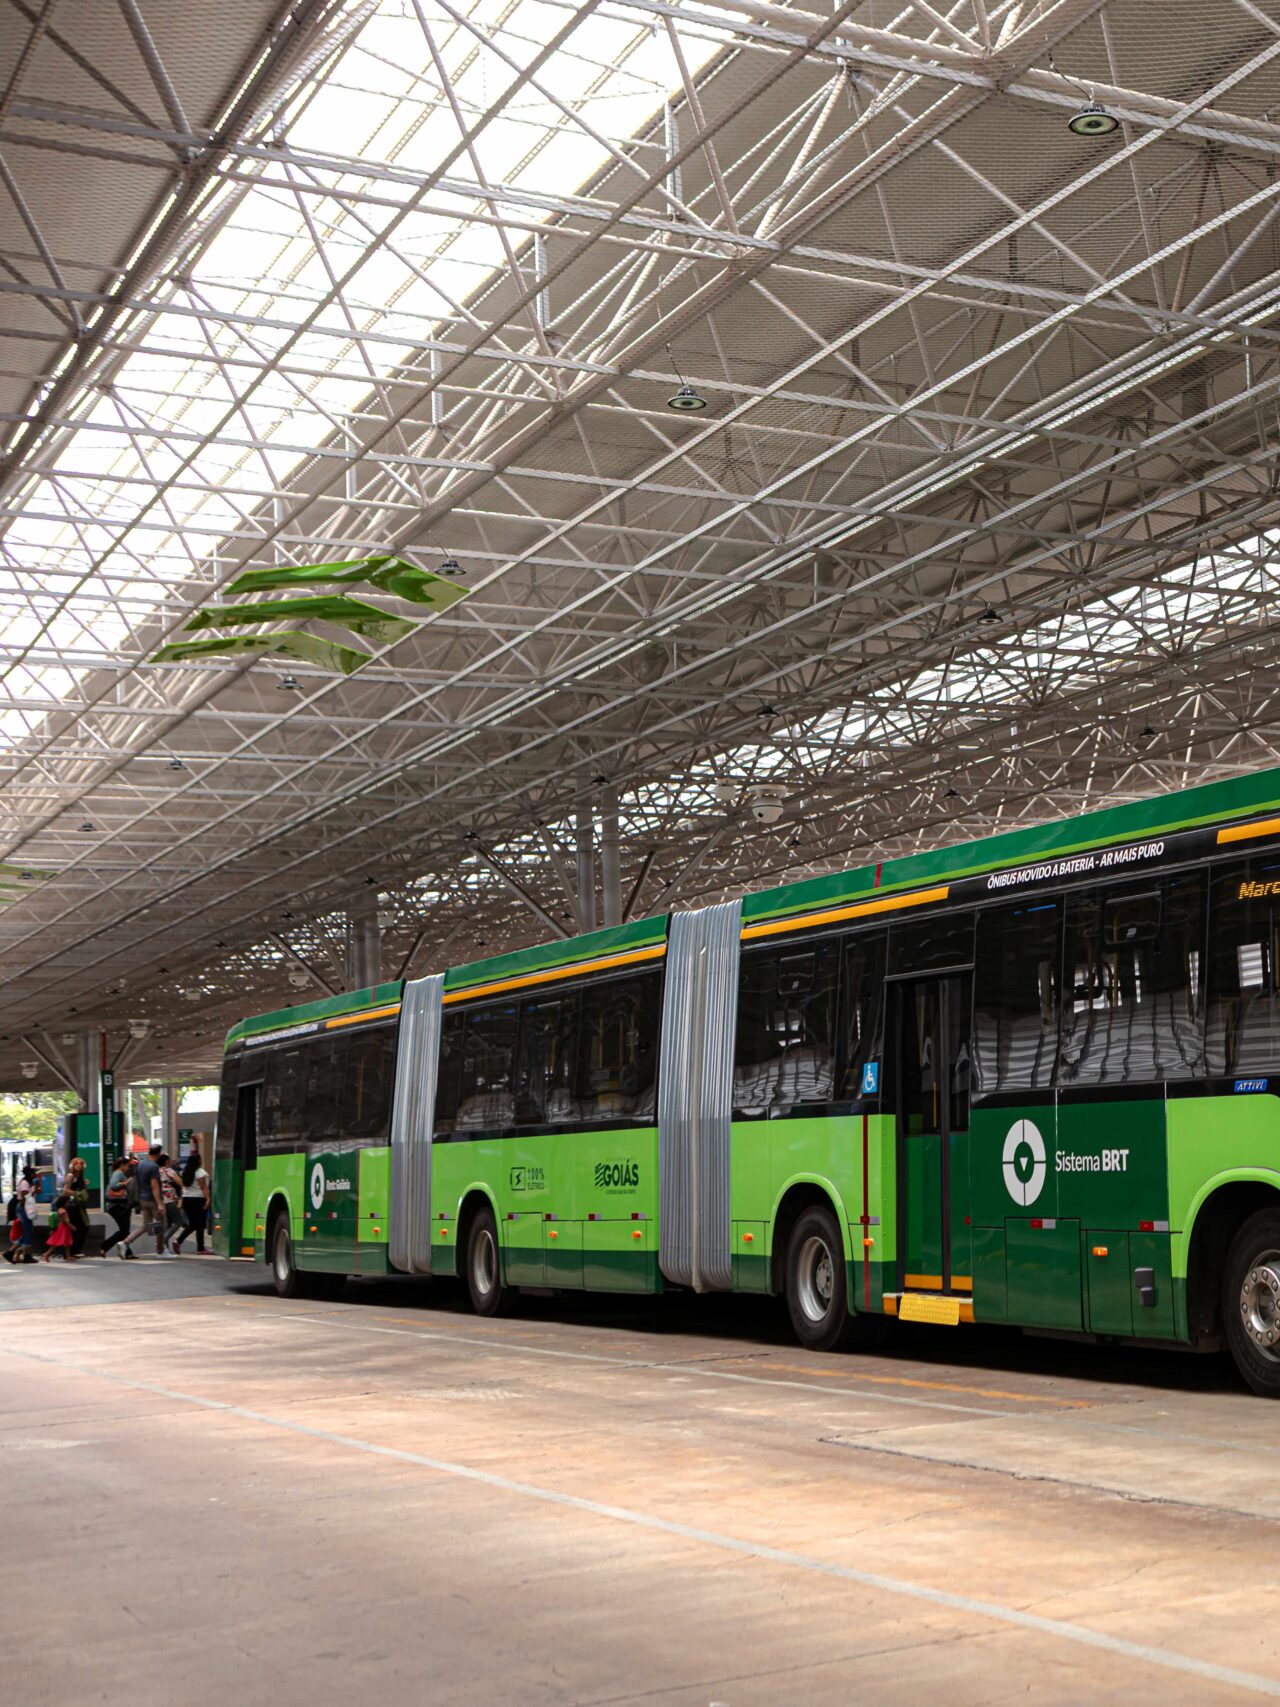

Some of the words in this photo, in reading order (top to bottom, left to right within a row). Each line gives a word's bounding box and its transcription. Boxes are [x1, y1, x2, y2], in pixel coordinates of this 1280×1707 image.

[987, 873, 1017, 889] ÔNIBUS
[1017, 865, 1051, 884] MOVIDO
[1052, 864, 1059, 876] A
[1059, 856, 1095, 875] BATERIA
[1100, 853, 1113, 867] AR
[1114, 847, 1137, 863] MAIS
[1137, 842, 1165, 861] PURO
[104, 1074, 113, 1086] B
[1055, 1150, 1101, 1172] Sistema
[1101, 1149, 1130, 1172] BRT
[527, 1167, 545, 1180] 100%
[603, 1158, 639, 1187] GOIÁS
